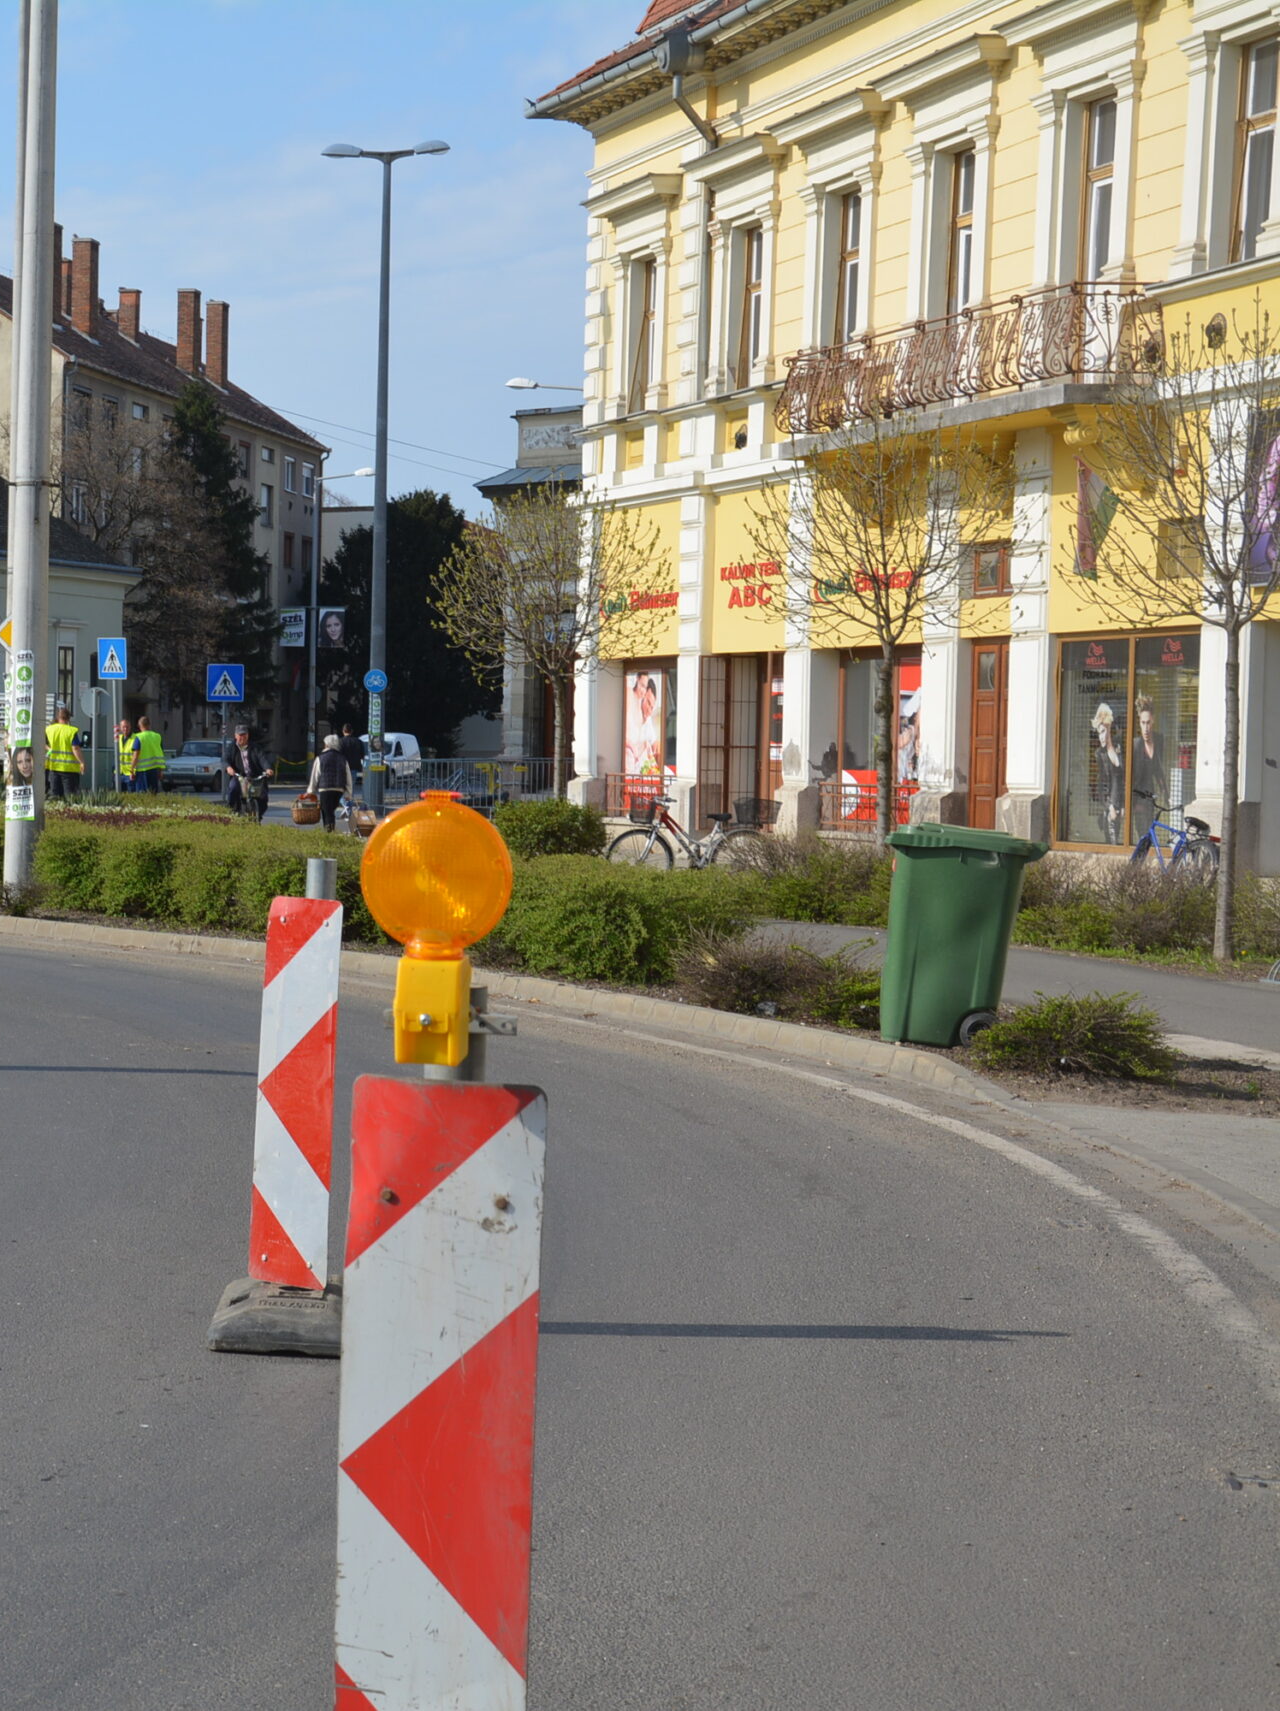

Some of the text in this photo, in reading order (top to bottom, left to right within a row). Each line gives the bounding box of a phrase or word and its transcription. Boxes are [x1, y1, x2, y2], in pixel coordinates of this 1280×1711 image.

[720, 562, 756, 581] KÁLVIN
[728, 584, 772, 608] ABC
[1086, 656, 1106, 665] WELLA
[1161, 653, 1184, 662] WELLA
